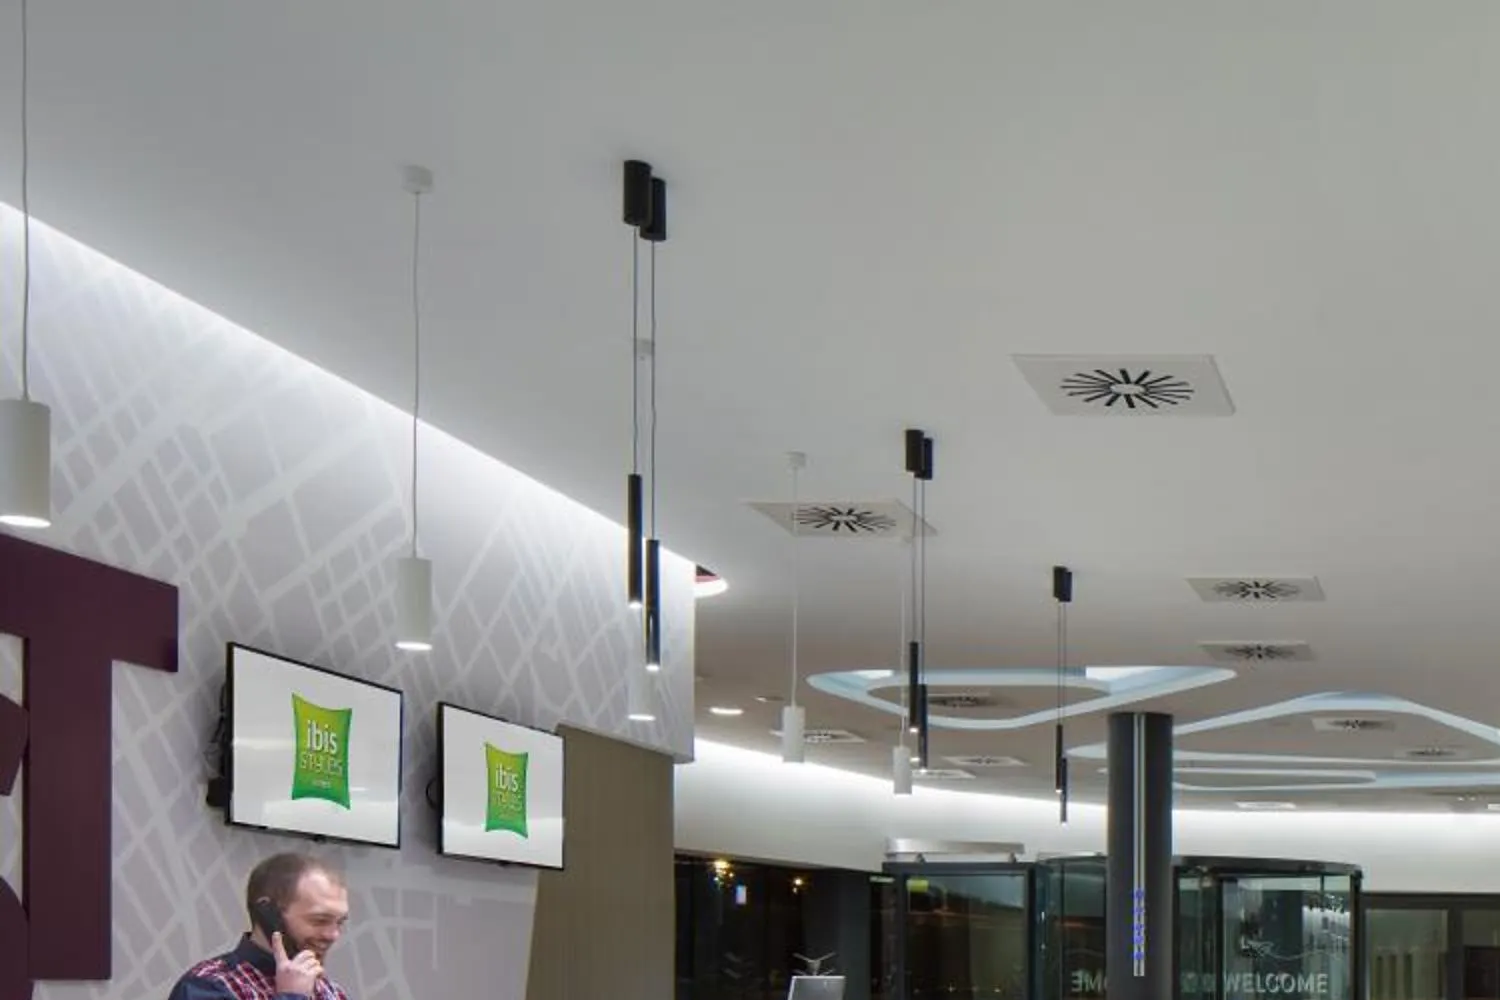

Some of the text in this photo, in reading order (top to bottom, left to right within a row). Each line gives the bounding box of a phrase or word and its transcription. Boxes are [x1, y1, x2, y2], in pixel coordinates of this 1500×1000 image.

[306, 719, 338, 755] ibis
[495, 763, 519, 792] ibis
[1222, 972, 1329, 994] WELCOME
